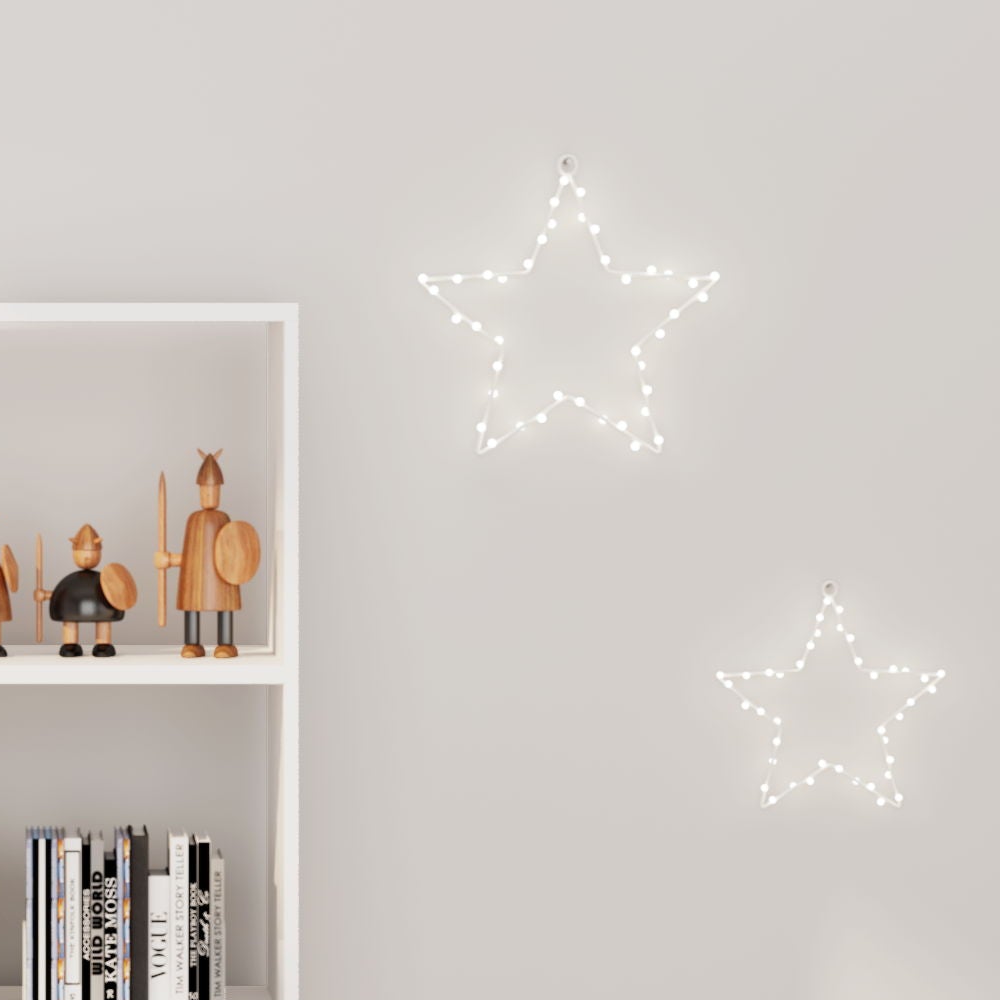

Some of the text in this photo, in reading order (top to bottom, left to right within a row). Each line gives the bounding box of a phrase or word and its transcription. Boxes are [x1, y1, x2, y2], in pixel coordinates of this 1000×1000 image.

[92, 871, 103, 975] WILD WORLD
[104, 877, 117, 983] KATE MOSS
[151, 911, 167, 979] VOGUE
[176, 844, 184, 994] TIM WALKER STORY TELLER
[214, 871, 222, 997] TIM WALKER STORY TELLER
